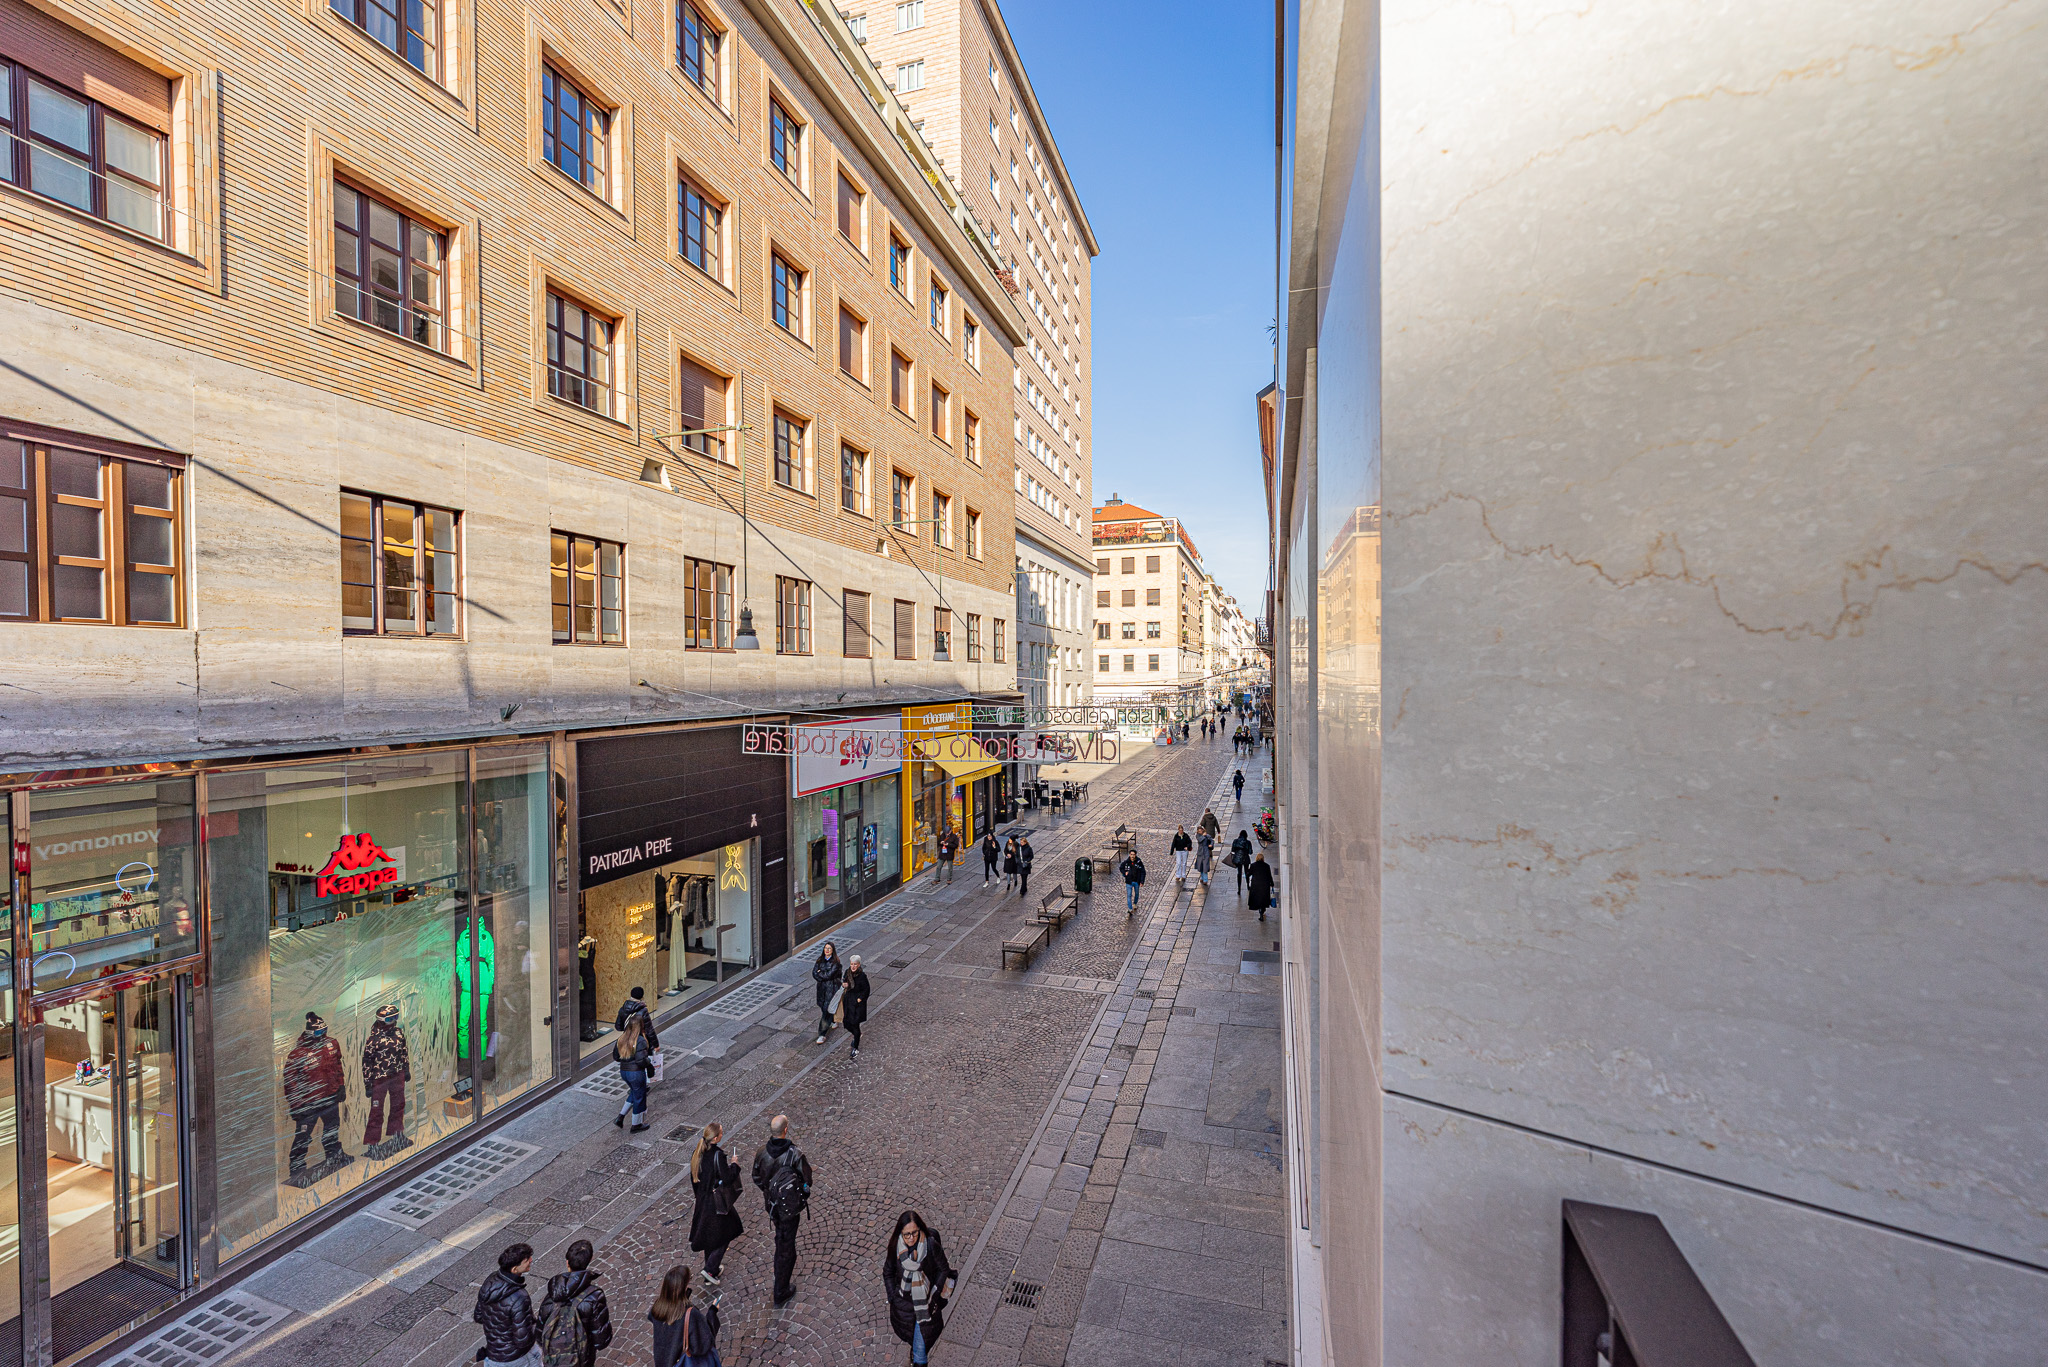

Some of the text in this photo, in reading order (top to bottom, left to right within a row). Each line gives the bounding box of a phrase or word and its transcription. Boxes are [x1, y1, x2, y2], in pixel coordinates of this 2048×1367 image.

[590, 837, 672, 875] PATRIZIA PEPE
[316, 867, 398, 898] Kappa
